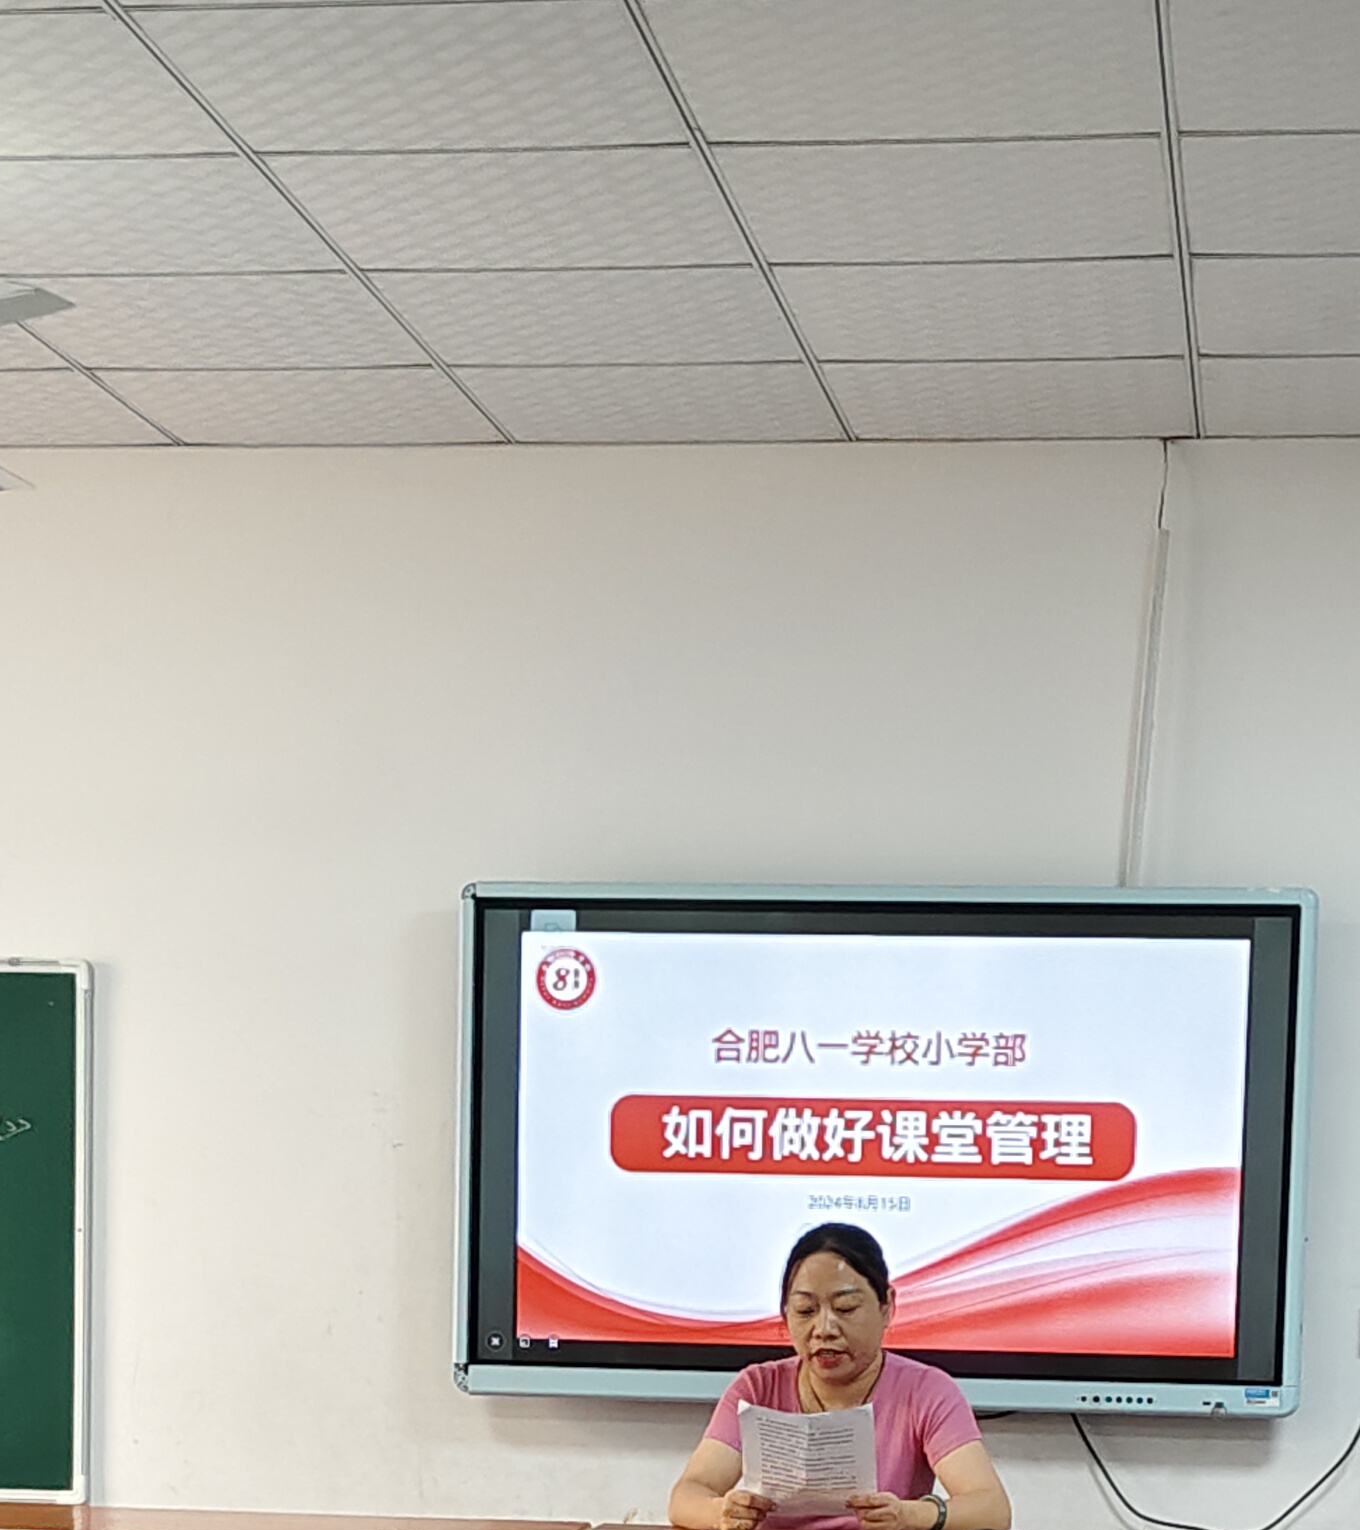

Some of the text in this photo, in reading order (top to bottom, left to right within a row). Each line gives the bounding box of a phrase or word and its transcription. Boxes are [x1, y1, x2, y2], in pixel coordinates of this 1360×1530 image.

[711, 1028, 1028, 1069] 合肥八一学校小学部
[662, 1105, 1094, 1167] 如何做好课堂管理
